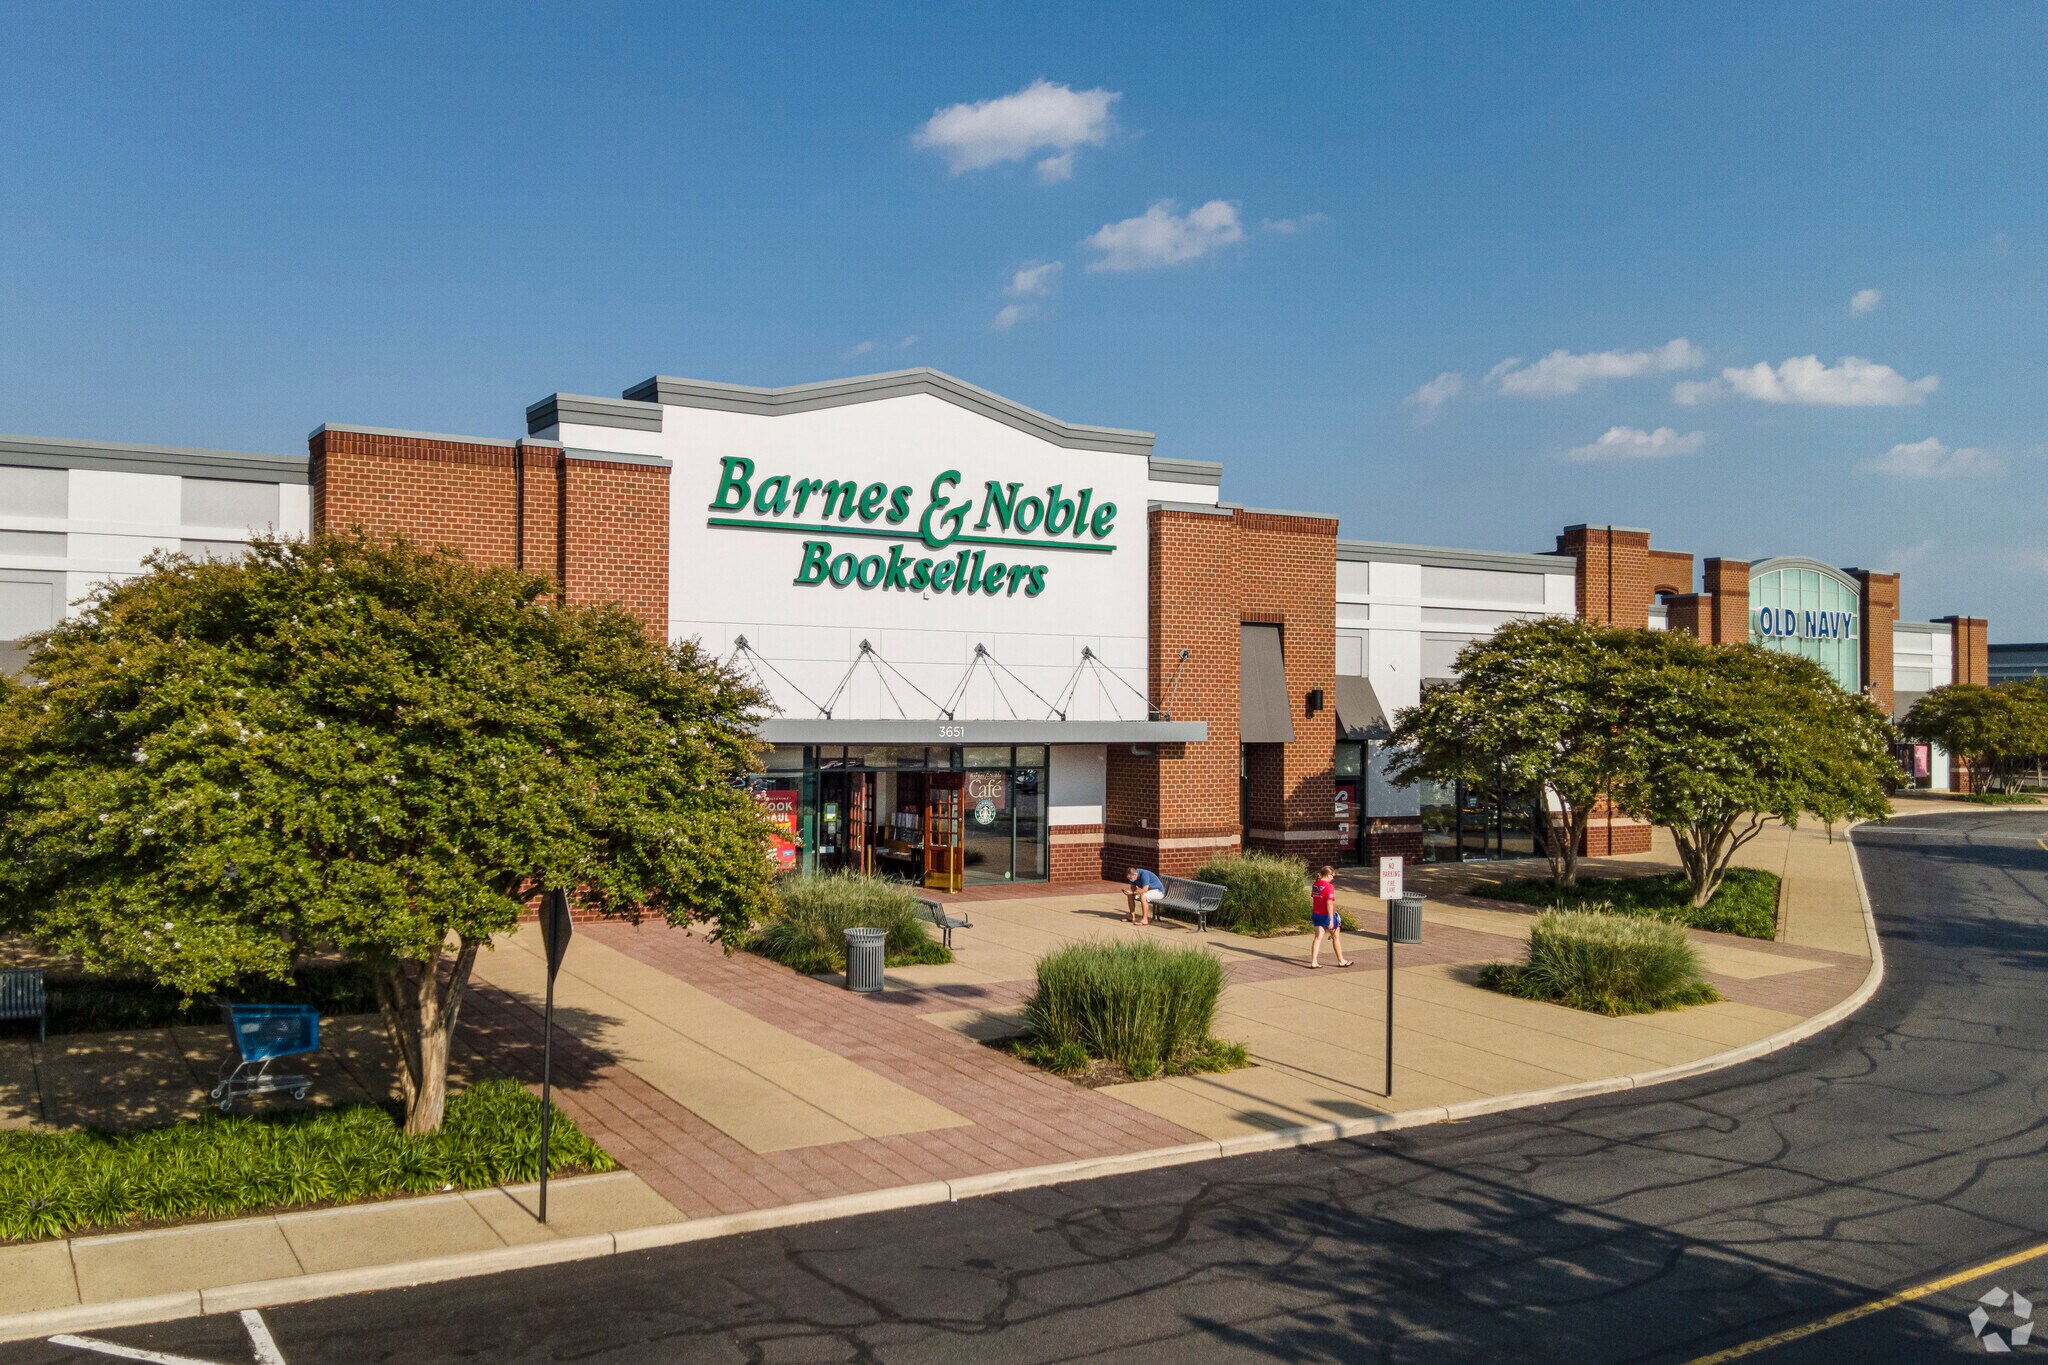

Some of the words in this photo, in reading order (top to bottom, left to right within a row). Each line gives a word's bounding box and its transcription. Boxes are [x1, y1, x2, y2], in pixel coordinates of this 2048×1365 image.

[709, 456, 913, 523] Barnes
[920, 470, 972, 548] &
[976, 480, 1117, 537] Noble
[794, 541, 1048, 596] Booksellers
[1760, 606, 1796, 637] OLD
[1804, 609, 1852, 640] NAVY
[938, 726, 965, 737] 3651
[969, 779, 1002, 798] Café
[768, 802, 793, 811] OOK
